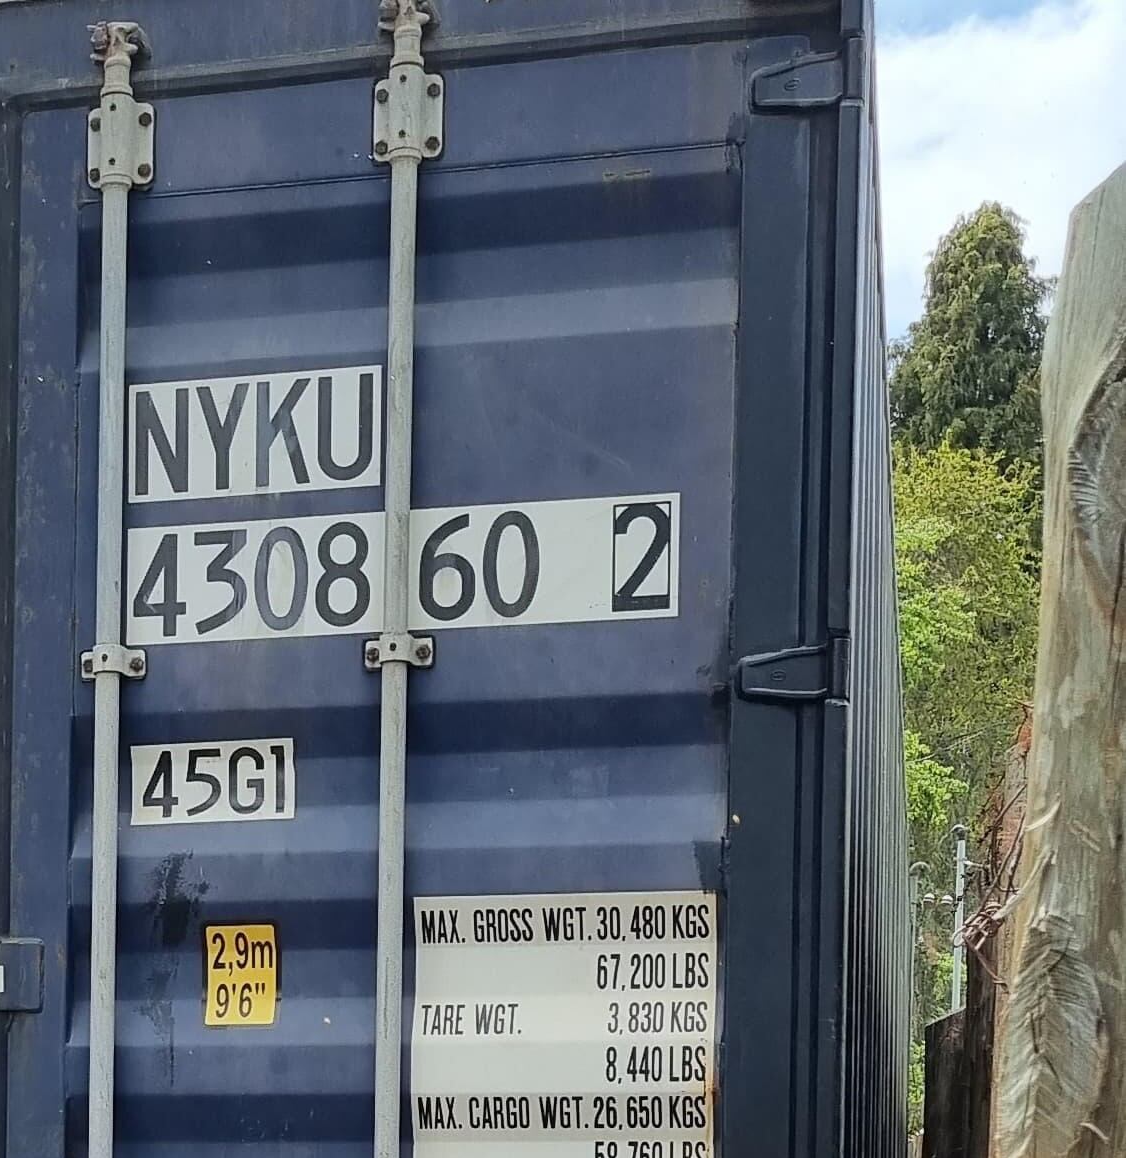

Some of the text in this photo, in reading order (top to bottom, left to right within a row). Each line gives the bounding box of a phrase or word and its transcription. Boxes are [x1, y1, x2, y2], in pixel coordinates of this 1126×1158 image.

[134, 373, 374, 496] NYKU
[612, 502, 671, 612] 2
[142, 745, 285, 818] 45G1
[421, 910, 466, 944] MAX.
[474, 908, 533, 943] GROSS
[542, 907, 592, 941] WGT.
[672, 904, 710, 939] KGS
[212, 932, 273, 976] 2,9m
[672, 953, 710, 989] LBS
[422, 1004, 466, 1035] TARE
[474, 1003, 523, 1035] WGT.
[670, 1001, 708, 1033] KGS
[669, 1046, 706, 1082] LBS
[418, 1096, 462, 1129] MAX.
[469, 1096, 530, 1129] CARGO
[538, 1096, 589, 1129] WGT.
[669, 1096, 706, 1129] KGS
